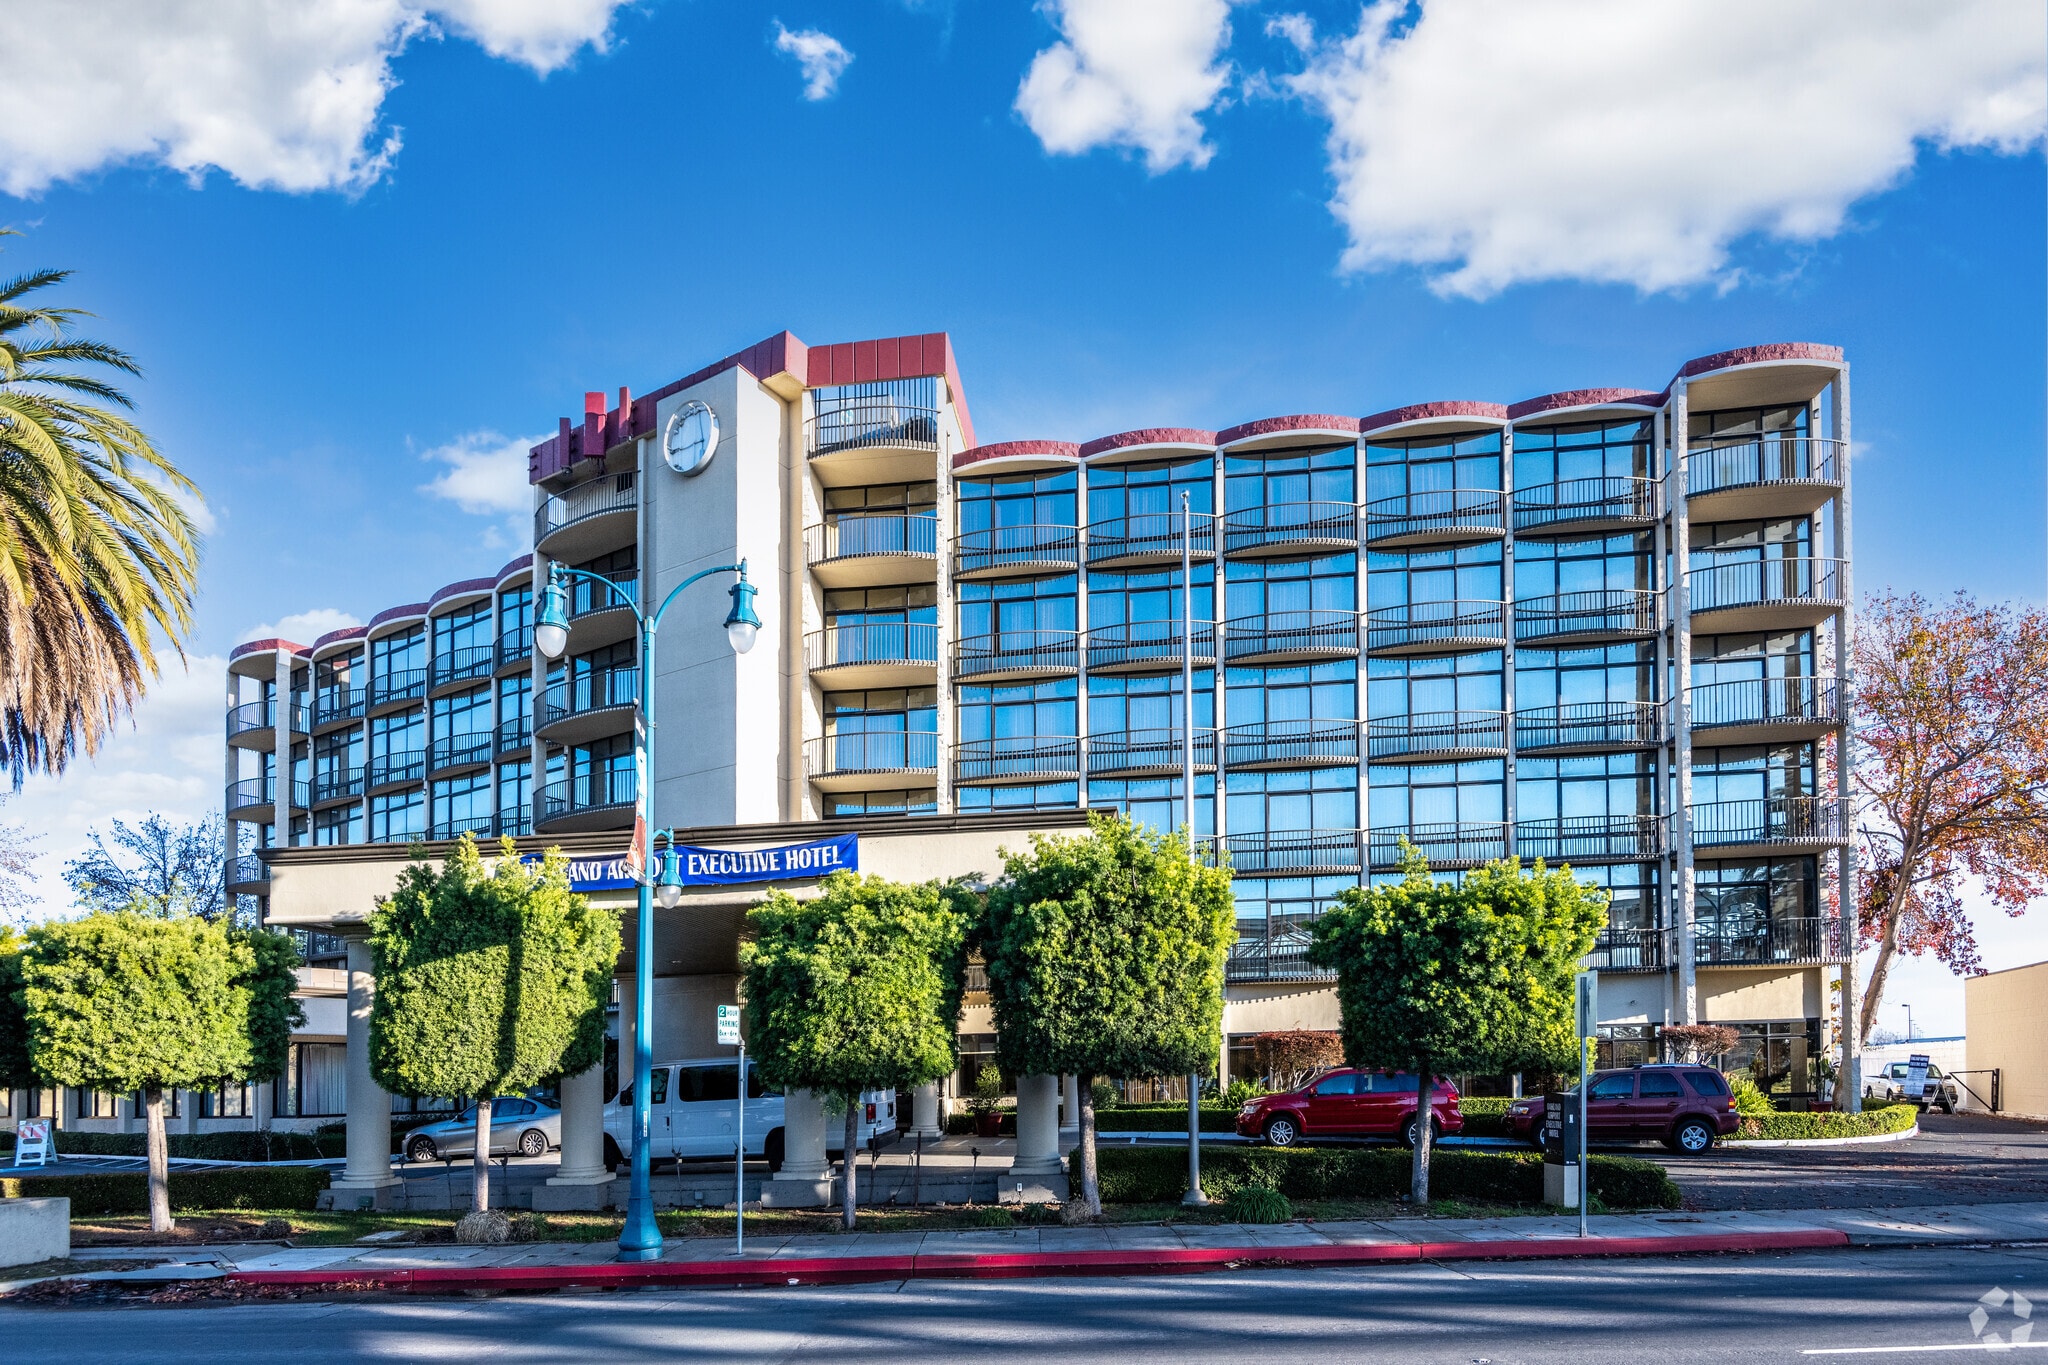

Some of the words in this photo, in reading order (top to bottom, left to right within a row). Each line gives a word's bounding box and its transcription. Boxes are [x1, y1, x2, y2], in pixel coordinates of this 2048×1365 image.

[688, 851, 780, 875] EXECUTIVE
[786, 845, 842, 869] HOTEL
[719, 1007, 725, 1016] 2
[719, 1020, 738, 1028] PARKING
